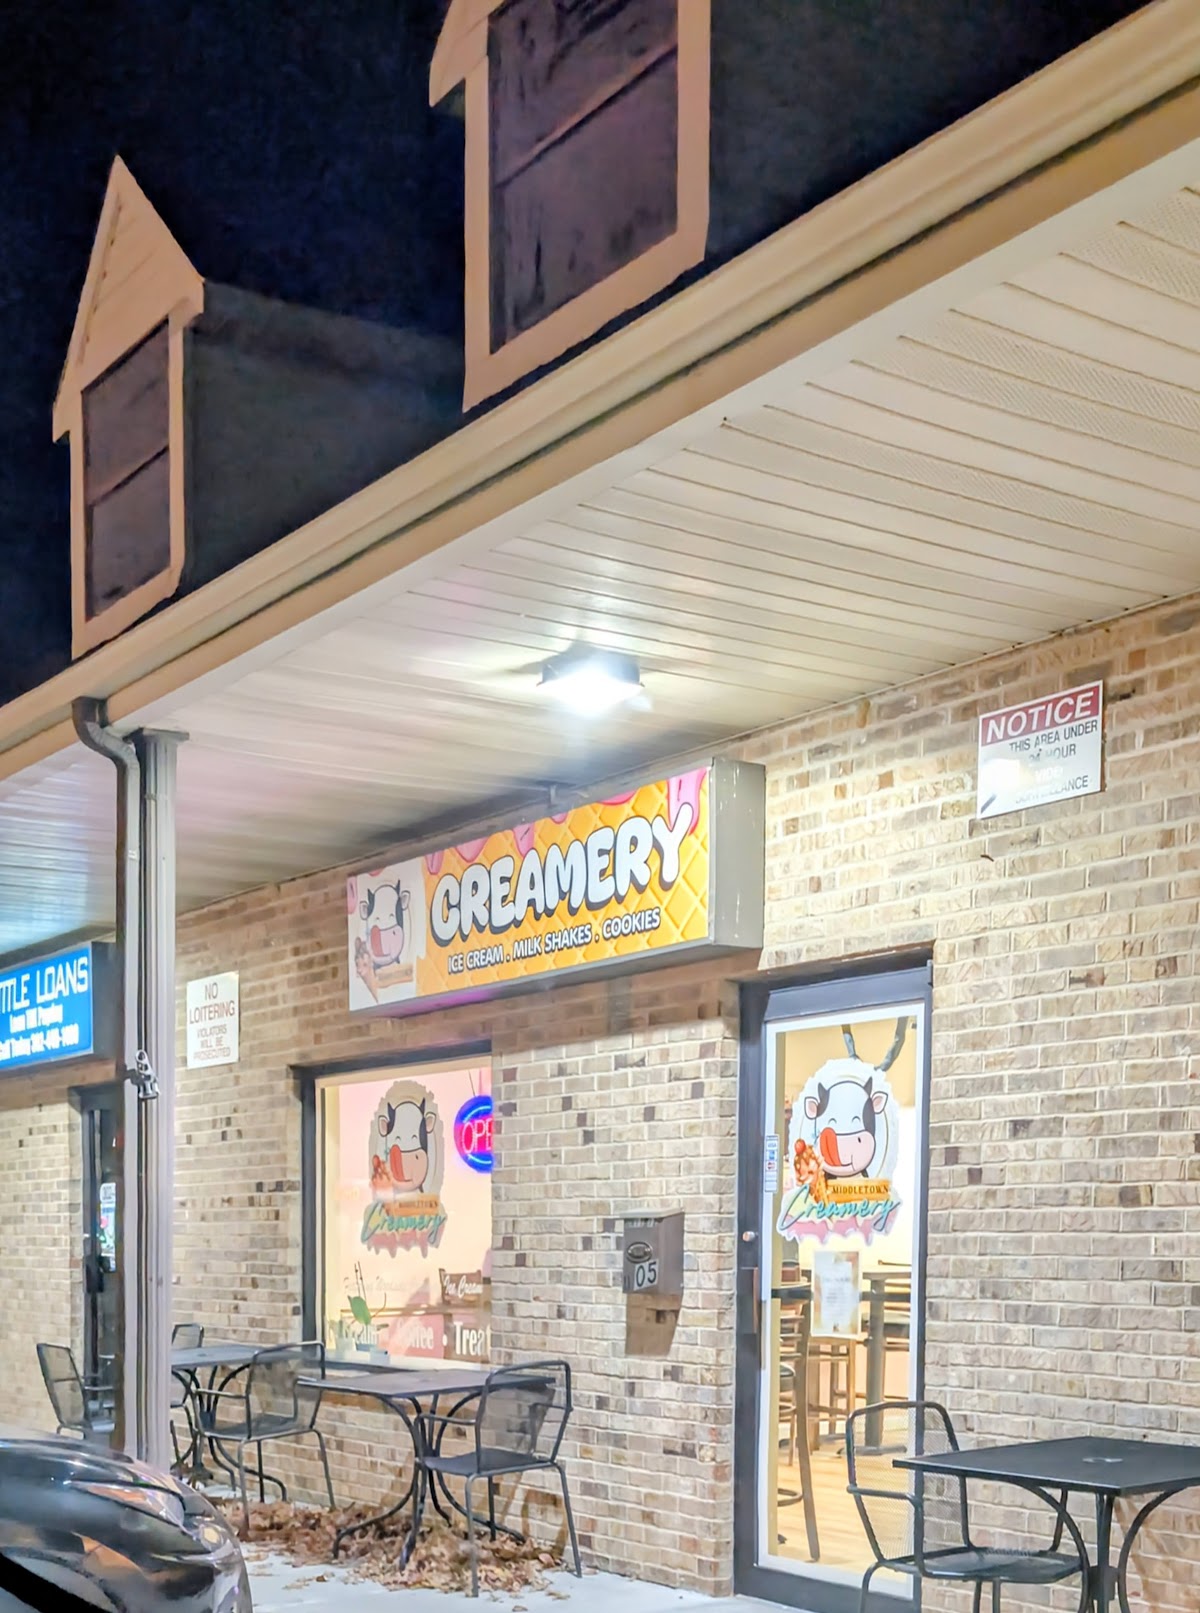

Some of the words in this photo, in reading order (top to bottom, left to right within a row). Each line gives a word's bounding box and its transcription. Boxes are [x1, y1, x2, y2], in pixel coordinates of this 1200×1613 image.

[986, 691, 1094, 743] NOTICE
[1009, 738, 1031, 752] THIS
[1034, 731, 1060, 747] AREA
[1064, 719, 1098, 740] UNDER
[431, 802, 694, 948] CREAMERY
[448, 953, 464, 974] ICE
[466, 945, 504, 971] CREAM
[512, 936, 543, 960] MILK
[544, 924, 592, 955] SHAKES
[602, 907, 661, 940] COOKIES
[0, 974, 30, 1015] ITLE
[36, 957, 88, 1004] LOANS
[205, 982, 218, 1000] NO
[190, 1000, 235, 1024] LOITERING
[462, 1118, 492, 1154] OPE
[780, 1184, 901, 1232] Creamery
[832, 1184, 889, 1194] MIDDLETOWN
[361, 1201, 446, 1245] Creamery
[636, 1262, 656, 1287] 05
